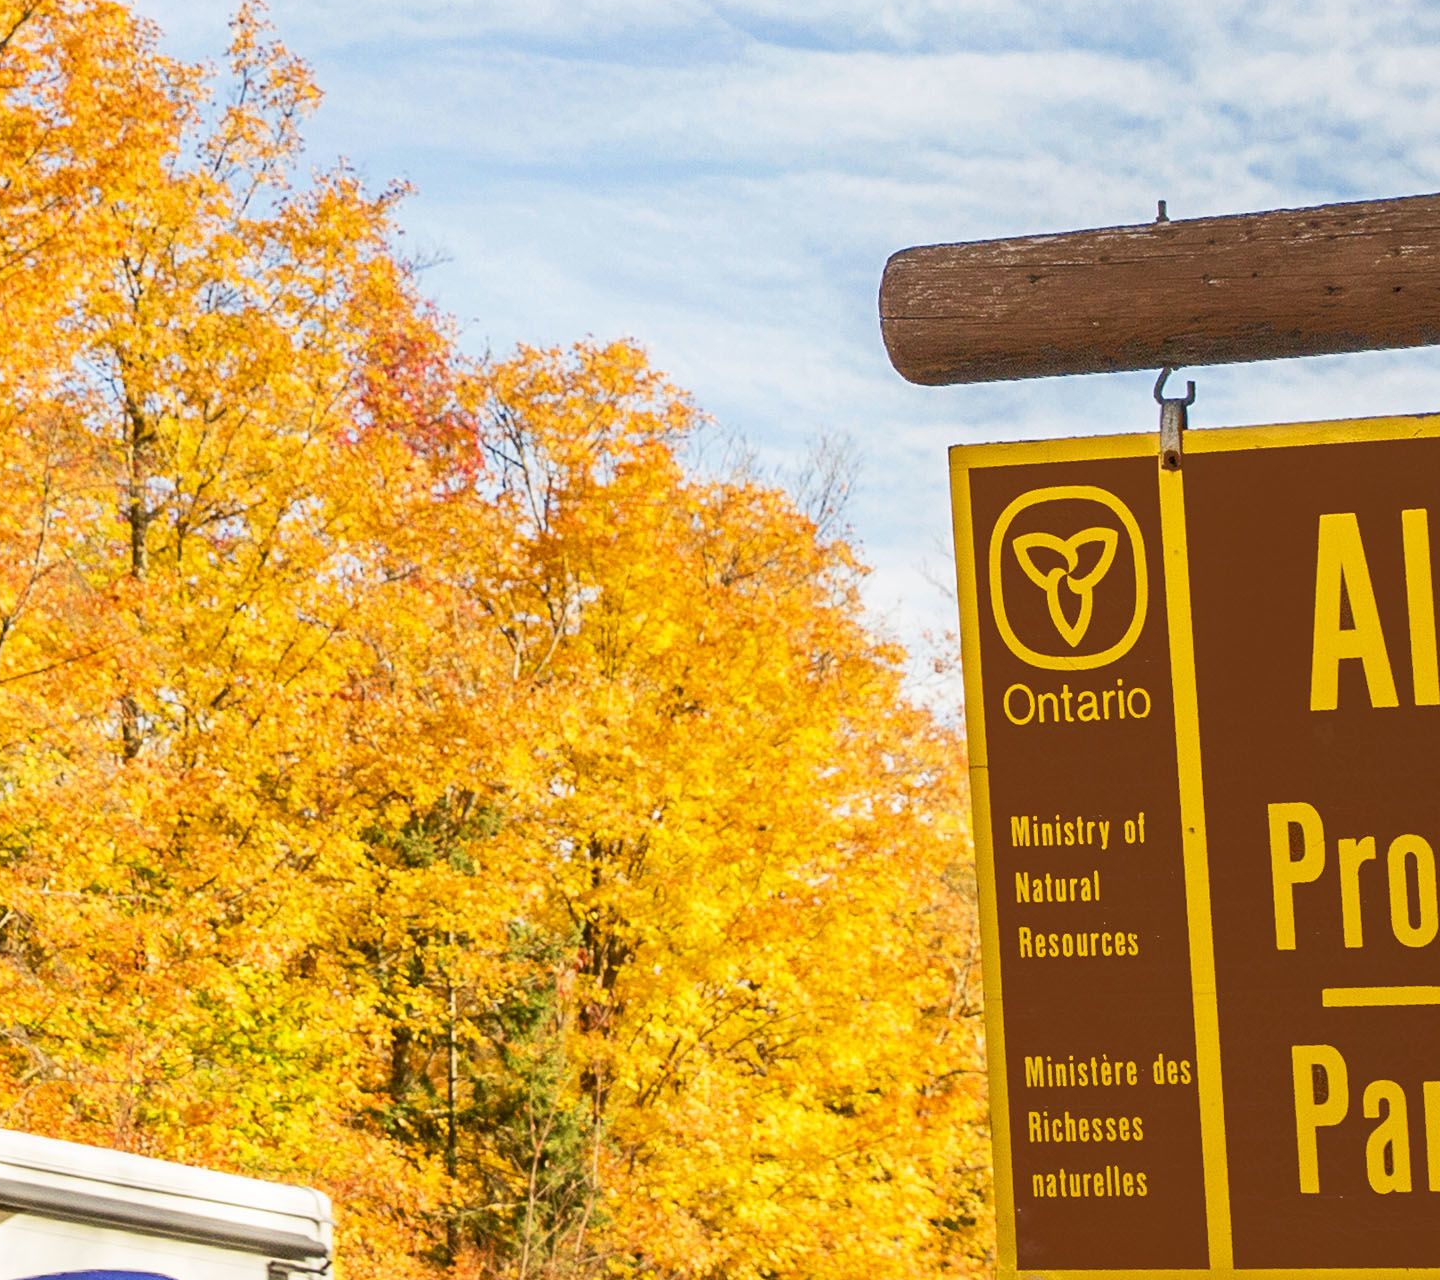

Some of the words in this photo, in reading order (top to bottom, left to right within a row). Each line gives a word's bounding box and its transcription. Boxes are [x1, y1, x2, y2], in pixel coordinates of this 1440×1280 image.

[1004, 679, 1151, 725] Ontario
[1011, 814, 1110, 850] Ministry
[1124, 812, 1145, 844] of
[1016, 870, 1101, 904] Natural
[1019, 927, 1139, 958] Resources
[1025, 1054, 1138, 1087] Ministère
[1153, 1053, 1192, 1085] des
[1029, 1111, 1144, 1143] Richesses
[1033, 1165, 1148, 1197] naturelles
